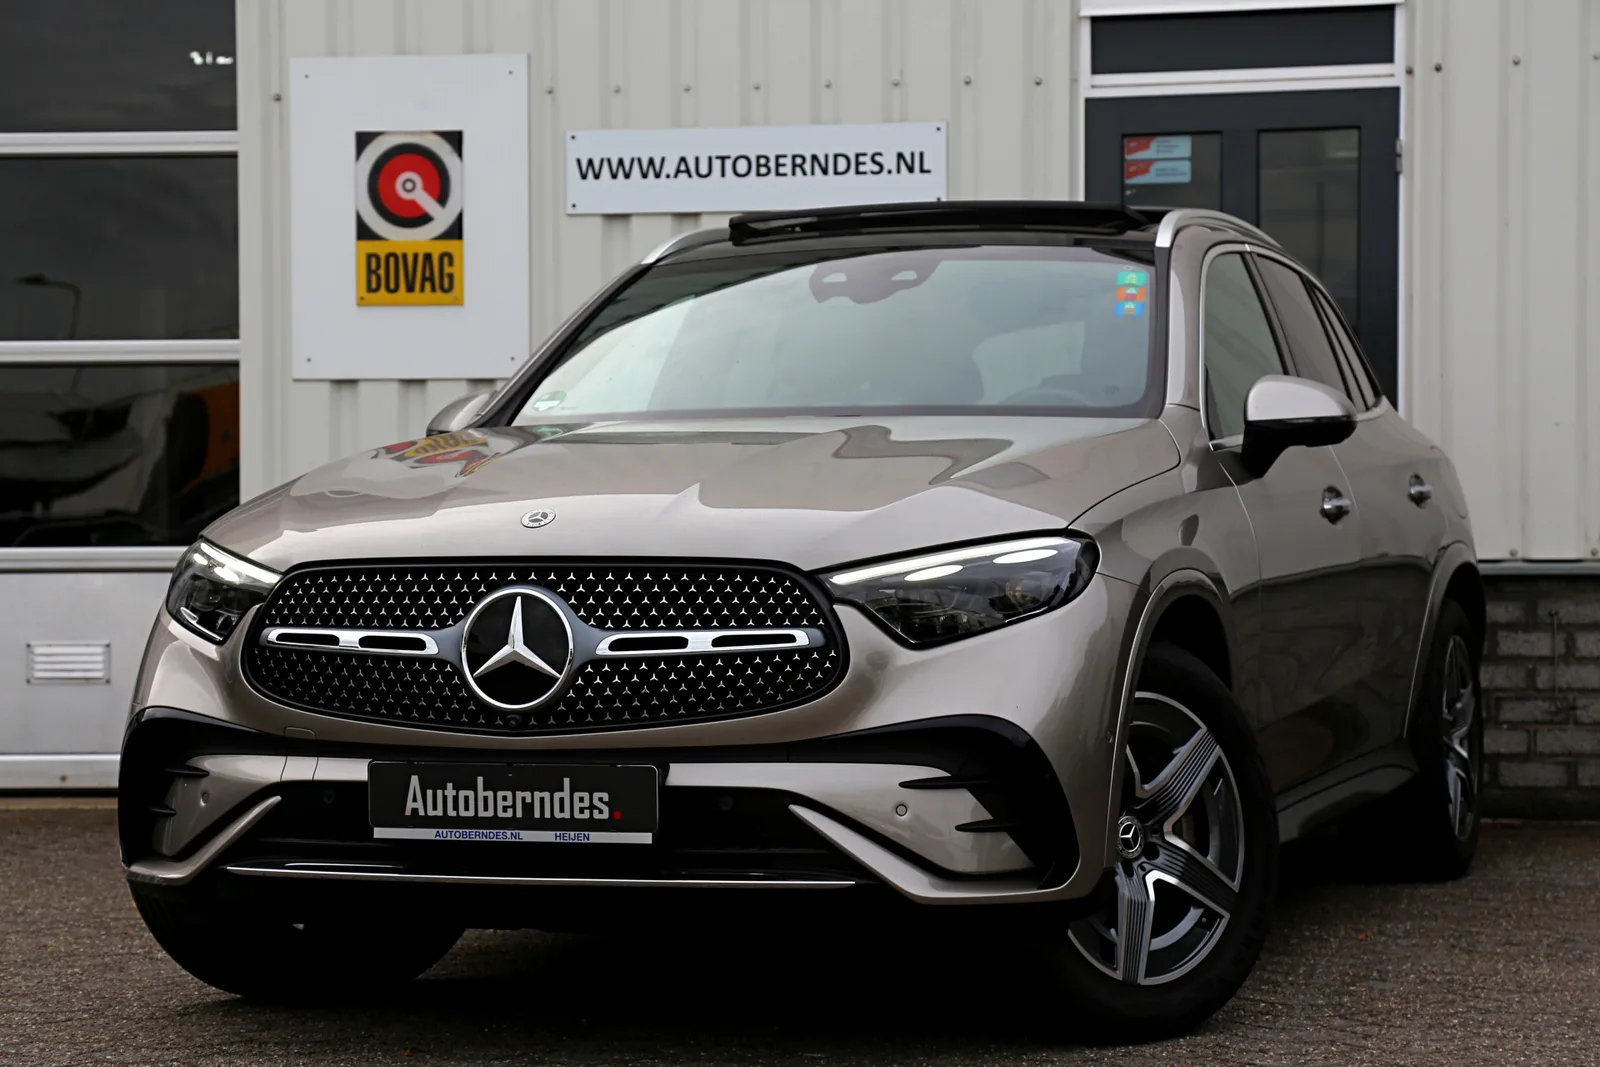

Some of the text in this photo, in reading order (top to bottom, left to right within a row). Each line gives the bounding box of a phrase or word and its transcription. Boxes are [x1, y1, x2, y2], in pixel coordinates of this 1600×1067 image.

[576, 151, 932, 180] WWW.AUTOBERNDES.NL
[366, 251, 455, 294] BOVAG
[405, 774, 622, 820] Autoberndes.
[434, 830, 590, 842] AUTOBERNDES.NL HEIJEN
